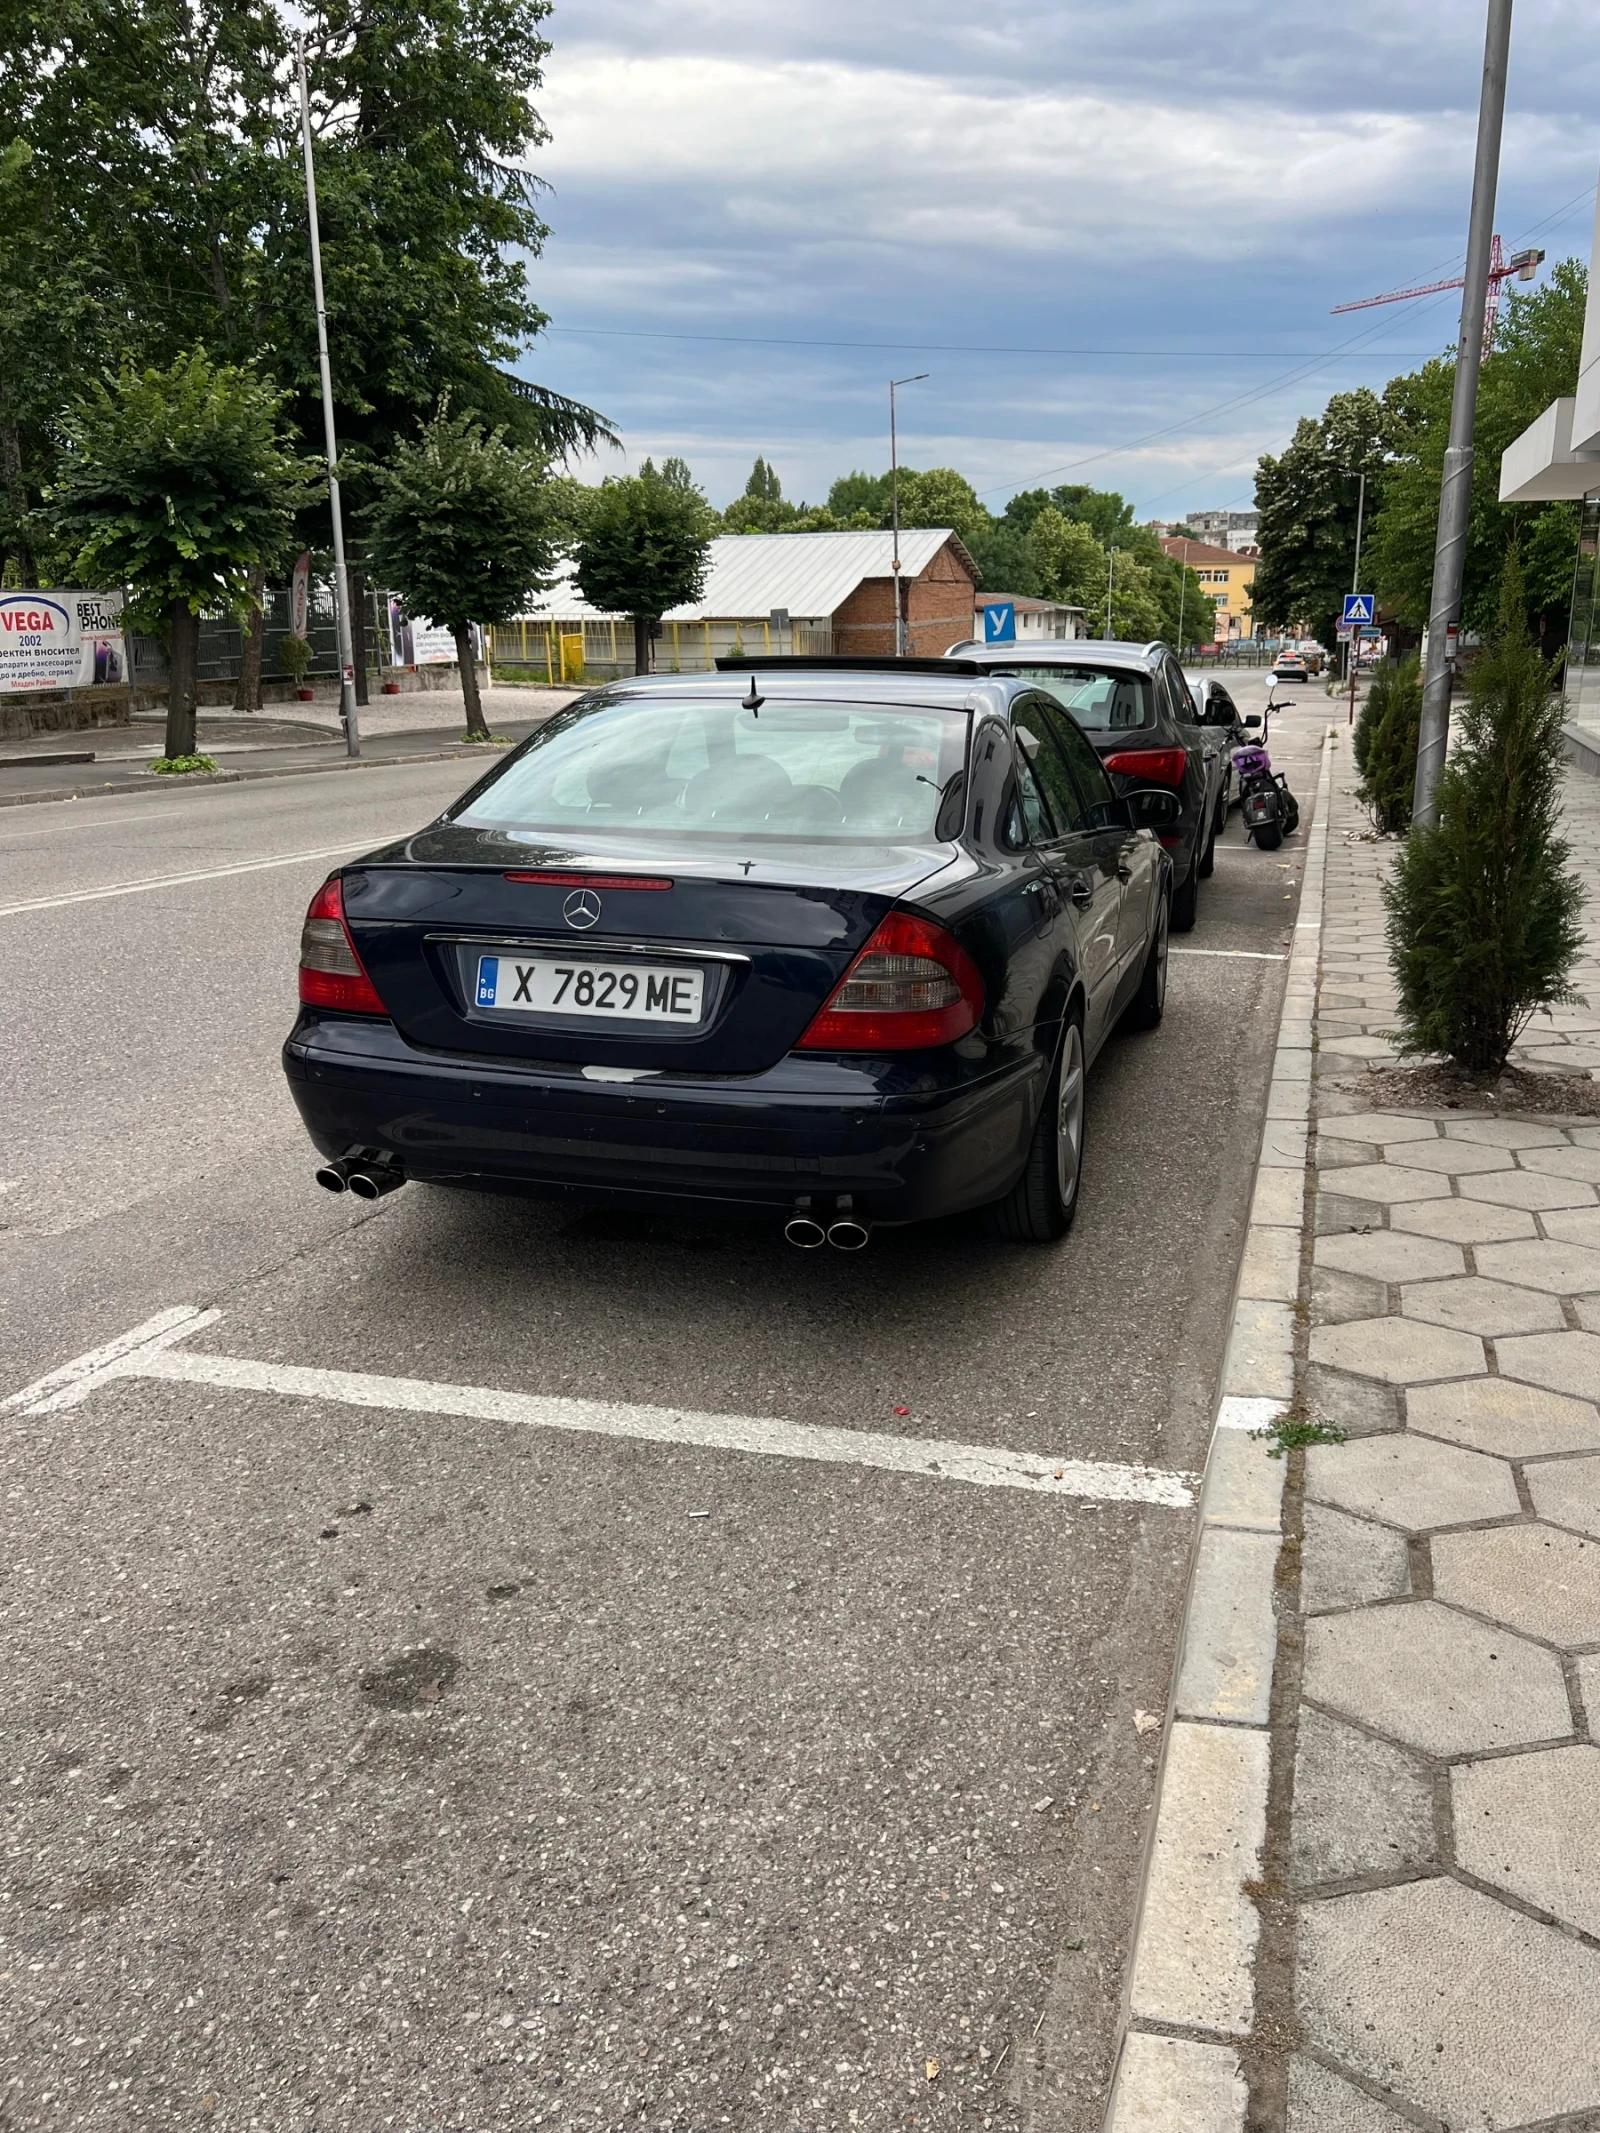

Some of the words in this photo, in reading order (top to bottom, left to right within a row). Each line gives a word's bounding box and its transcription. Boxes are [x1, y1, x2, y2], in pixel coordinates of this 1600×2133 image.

[76, 603, 102, 617] BEST
[0, 611, 54, 632] VEGA
[18, 635, 42, 647] 2002
[34, 647, 80, 657] вносител
[36, 659, 74, 668] аксесоари
[480, 987, 495, 1000] BG
[511, 965, 536, 1003] X
[551, 968, 639, 1010] 7829
[644, 974, 694, 1015] ME
